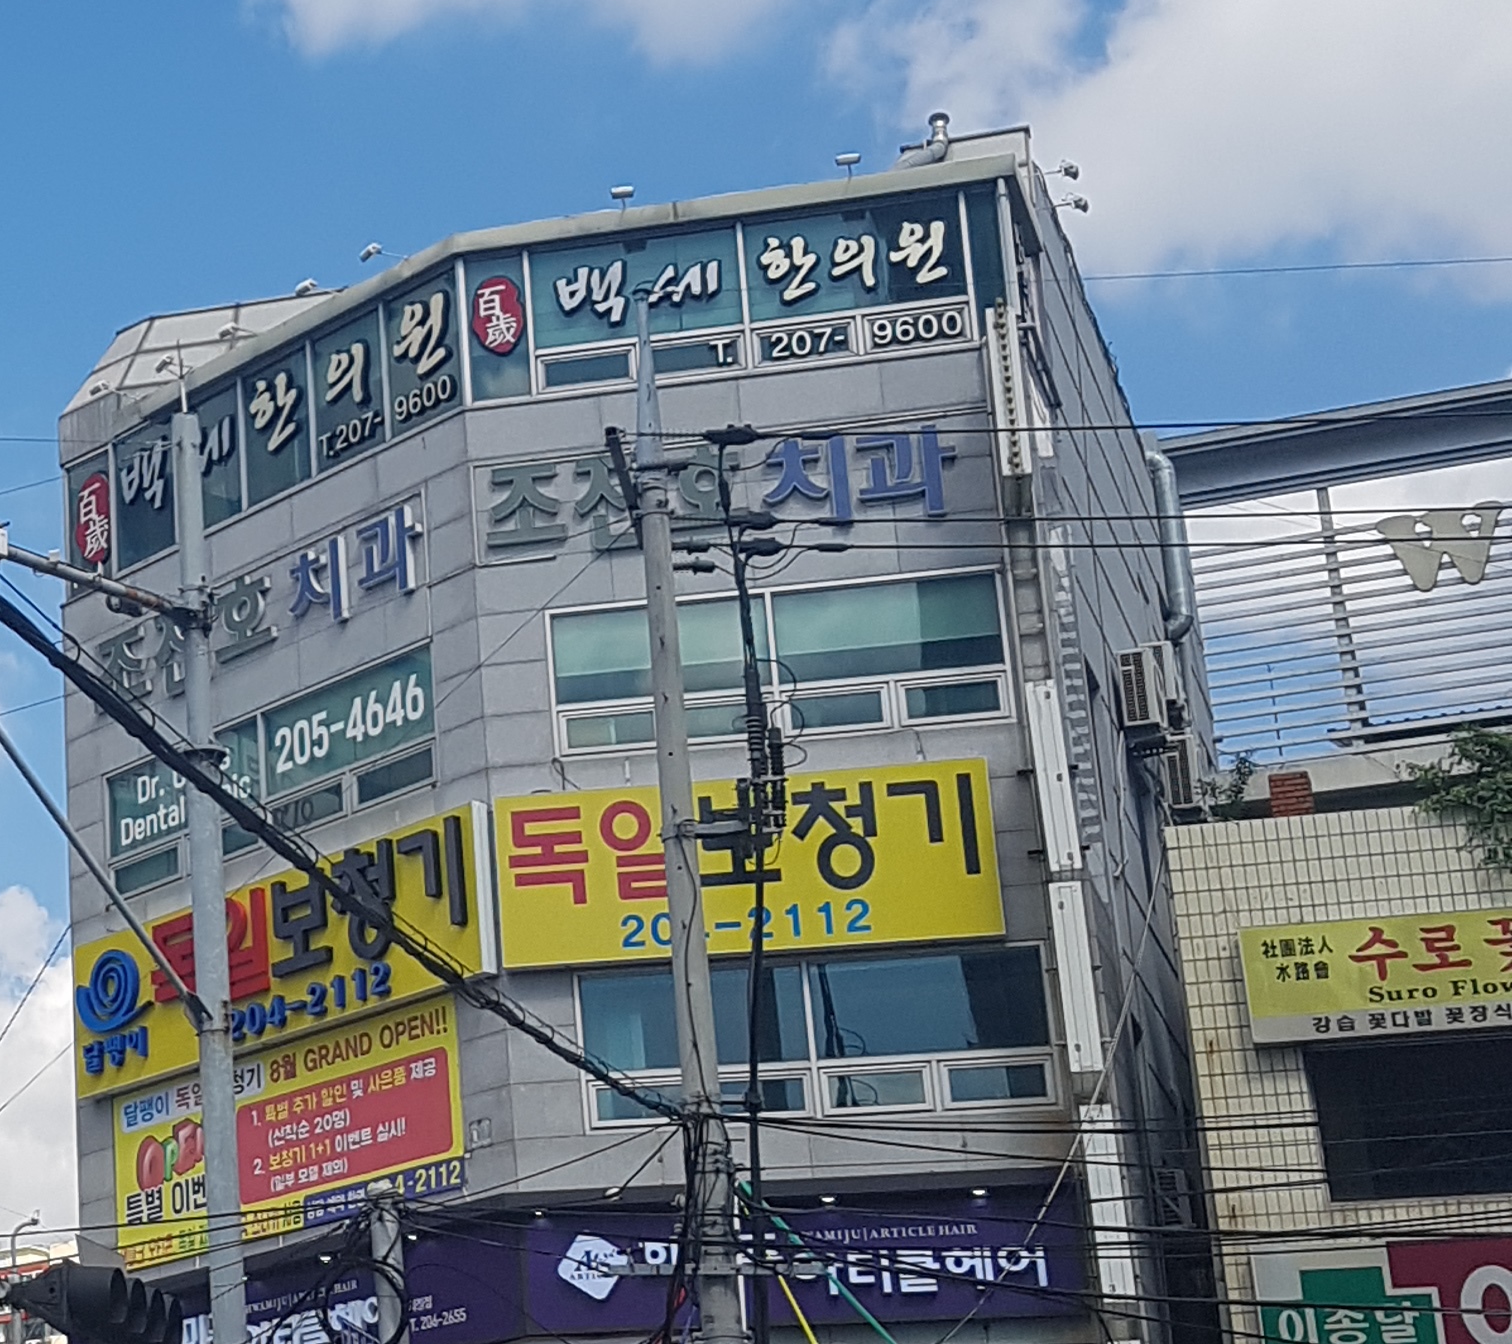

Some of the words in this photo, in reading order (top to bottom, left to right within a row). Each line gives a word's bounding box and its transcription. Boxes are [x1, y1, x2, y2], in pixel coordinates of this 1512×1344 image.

[488, 446, 738, 551] 조호
[762, 426, 958, 526] 치과
[289, 505, 423, 622] 치과
[275, 674, 425, 774] 205-4646
[138, 775, 165, 804] Dr.
[120, 795, 186, 846] Dental
[508, 772, 982, 905] 독일보청기
[621, 898, 872, 948] 20-2112
[1369, 984, 1438, 1003] Suro
[1313, 1014, 1355, 1033] 강습
[1368, 1008, 1433, 1030] 꽃다발
[82, 1026, 148, 1074] 달팽이
[122, 1090, 171, 1128] 달팽이
[304, 1031, 373, 1074] GRAND
[379, 1006, 449, 1049] OPEN!!
[309, 1139, 331, 1159] 1+1
[335, 1127, 372, 1153] 이벤트
[172, 1173, 206, 1215] 이벤
